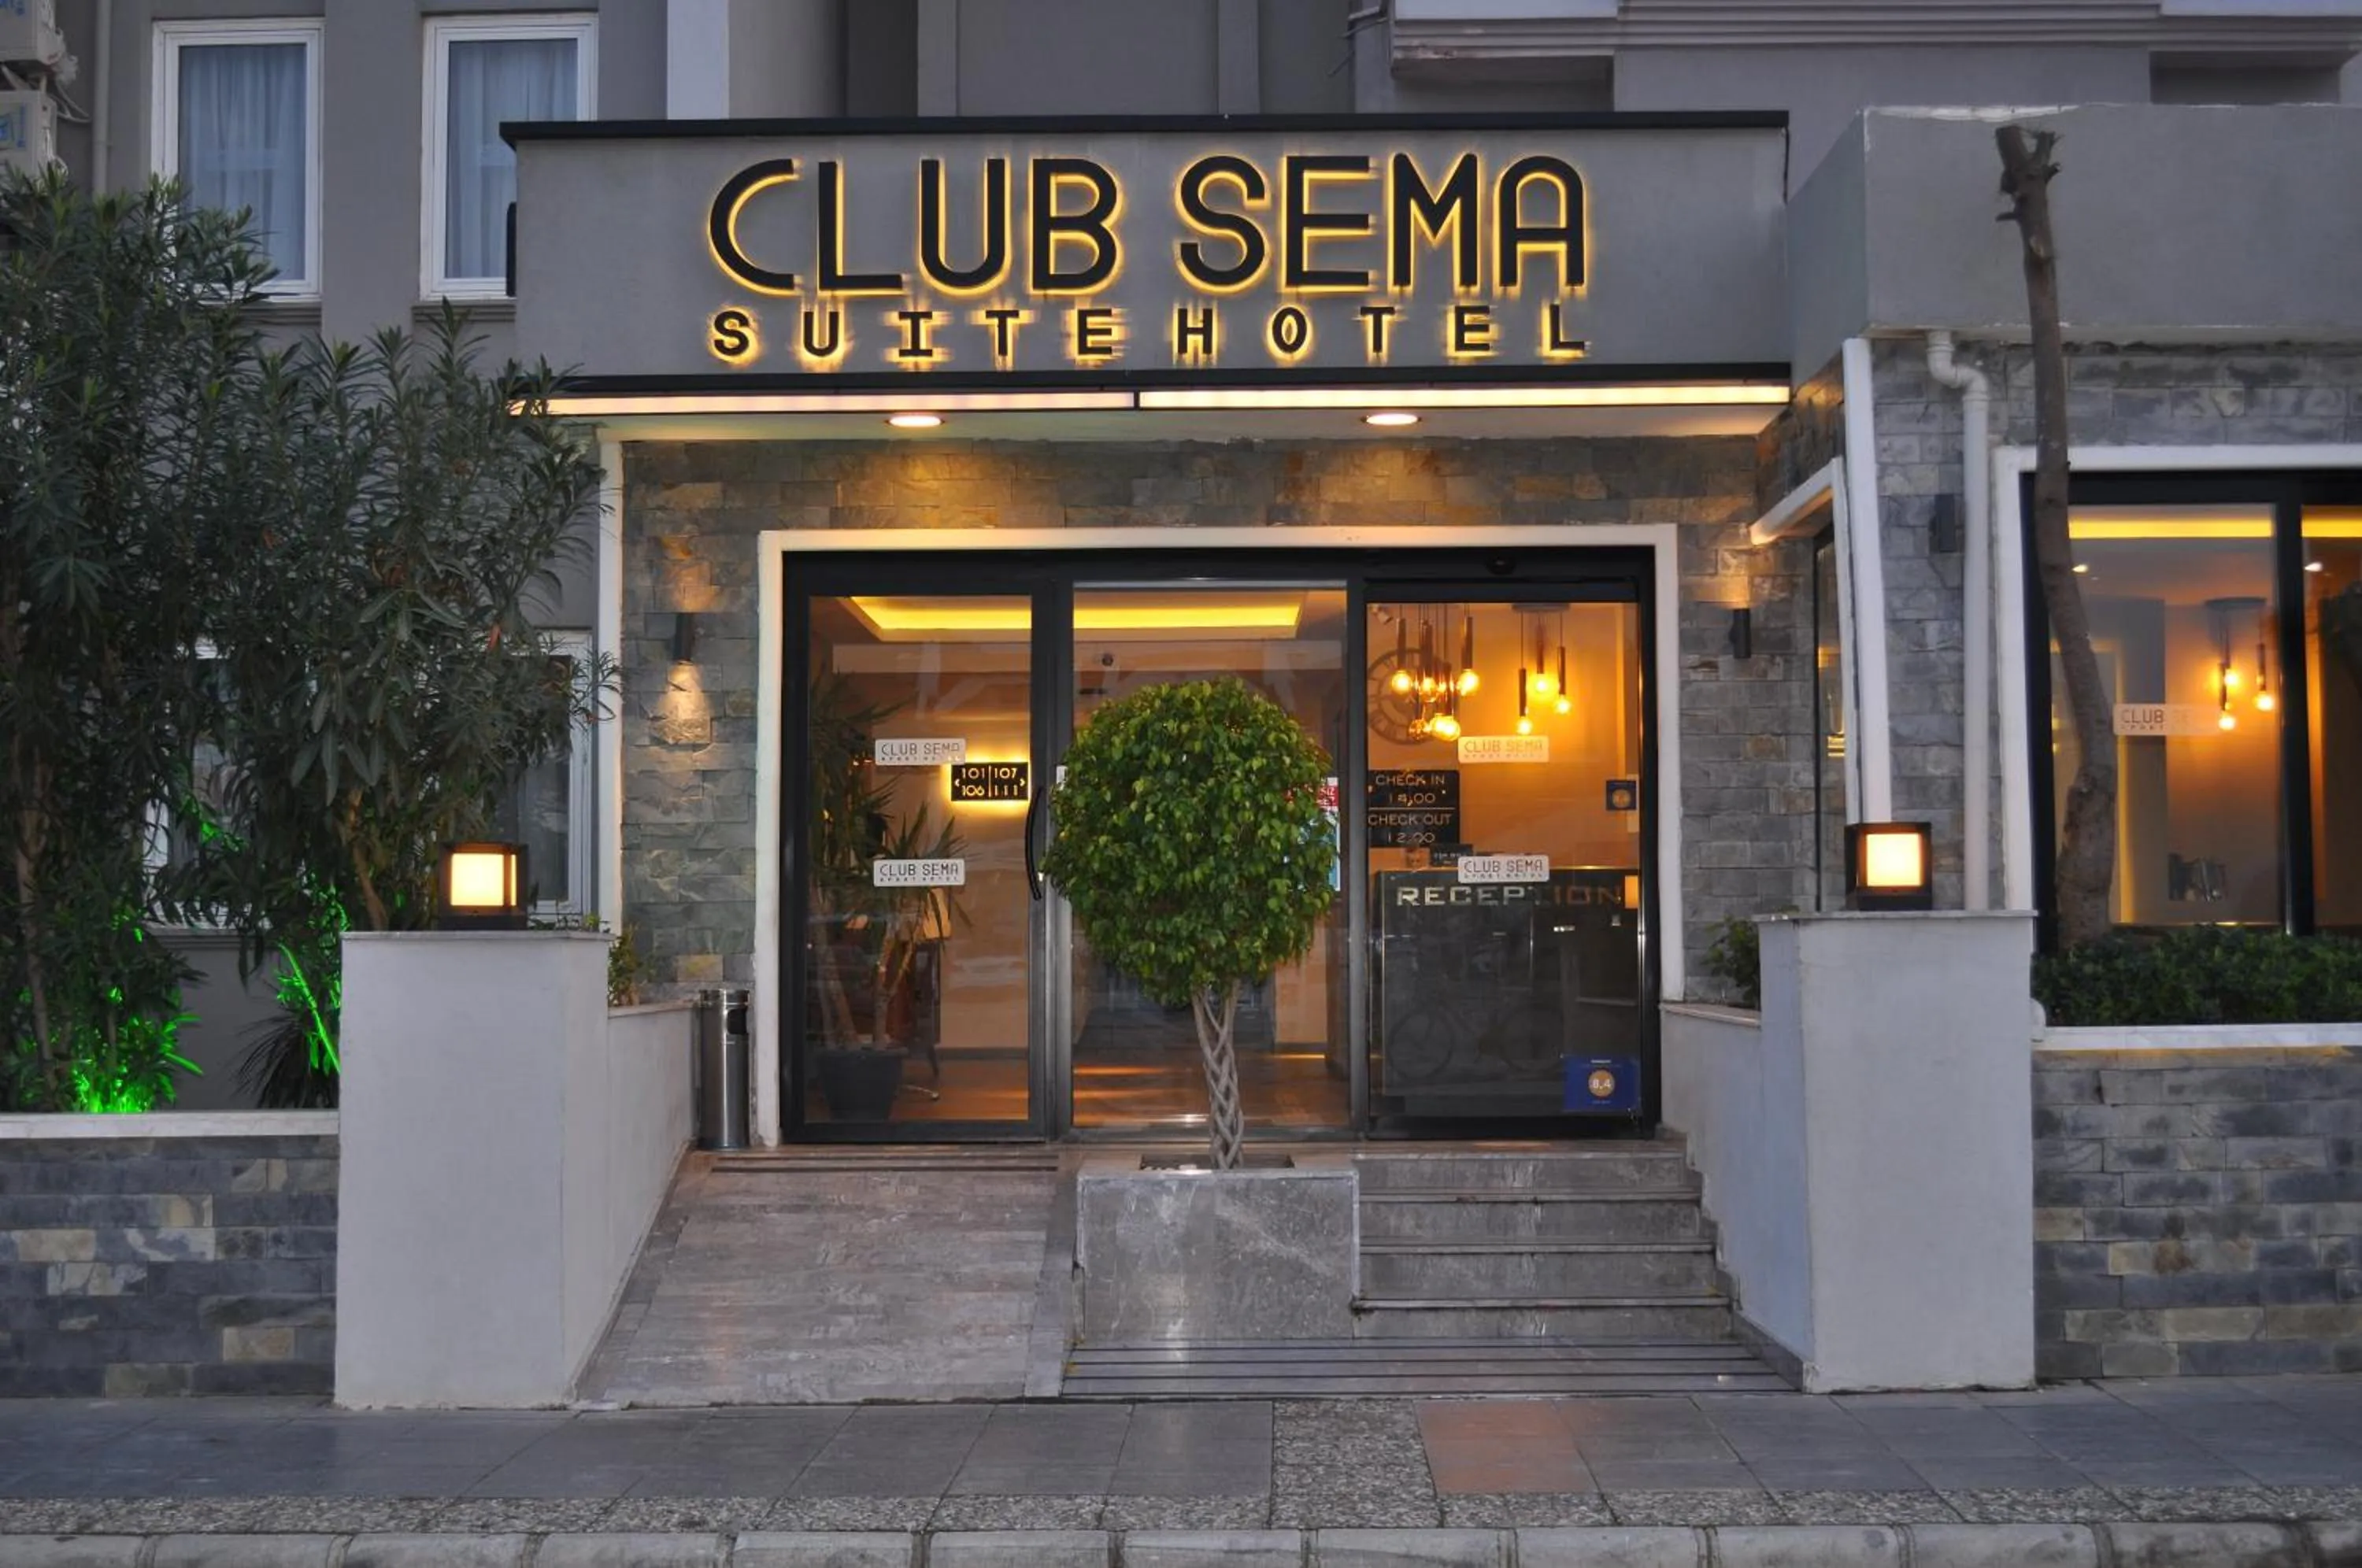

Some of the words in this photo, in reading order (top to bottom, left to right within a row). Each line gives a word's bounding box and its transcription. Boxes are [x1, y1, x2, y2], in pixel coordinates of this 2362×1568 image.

[708, 157, 1119, 292] CLUB
[1176, 153, 1586, 292] SEMA
[712, 308, 1115, 357] SUITE
[1176, 305, 1586, 354] HOTEL
[2121, 709, 2164, 723] CLUB
[881, 742, 918, 756] CLUB
[924, 742, 960, 756] SEMA
[1464, 739, 1501, 753] CLUB
[1505, 739, 1543, 753] SEMA
[961, 767, 986, 779] 101
[994, 767, 1017, 779] 107
[1375, 774, 1427, 786] CHECK
[1431, 774, 1446, 785] IN
[961, 785, 985, 797] 106
[994, 785, 1018, 797] 111
[1368, 814, 1419, 827] CHECK
[1423, 813, 1453, 826] OUT
[879, 864, 916, 876] CLUB
[922, 863, 958, 876] SEMA
[1464, 860, 1501, 873] CLUB
[1506, 858, 1543, 872] SEMA
